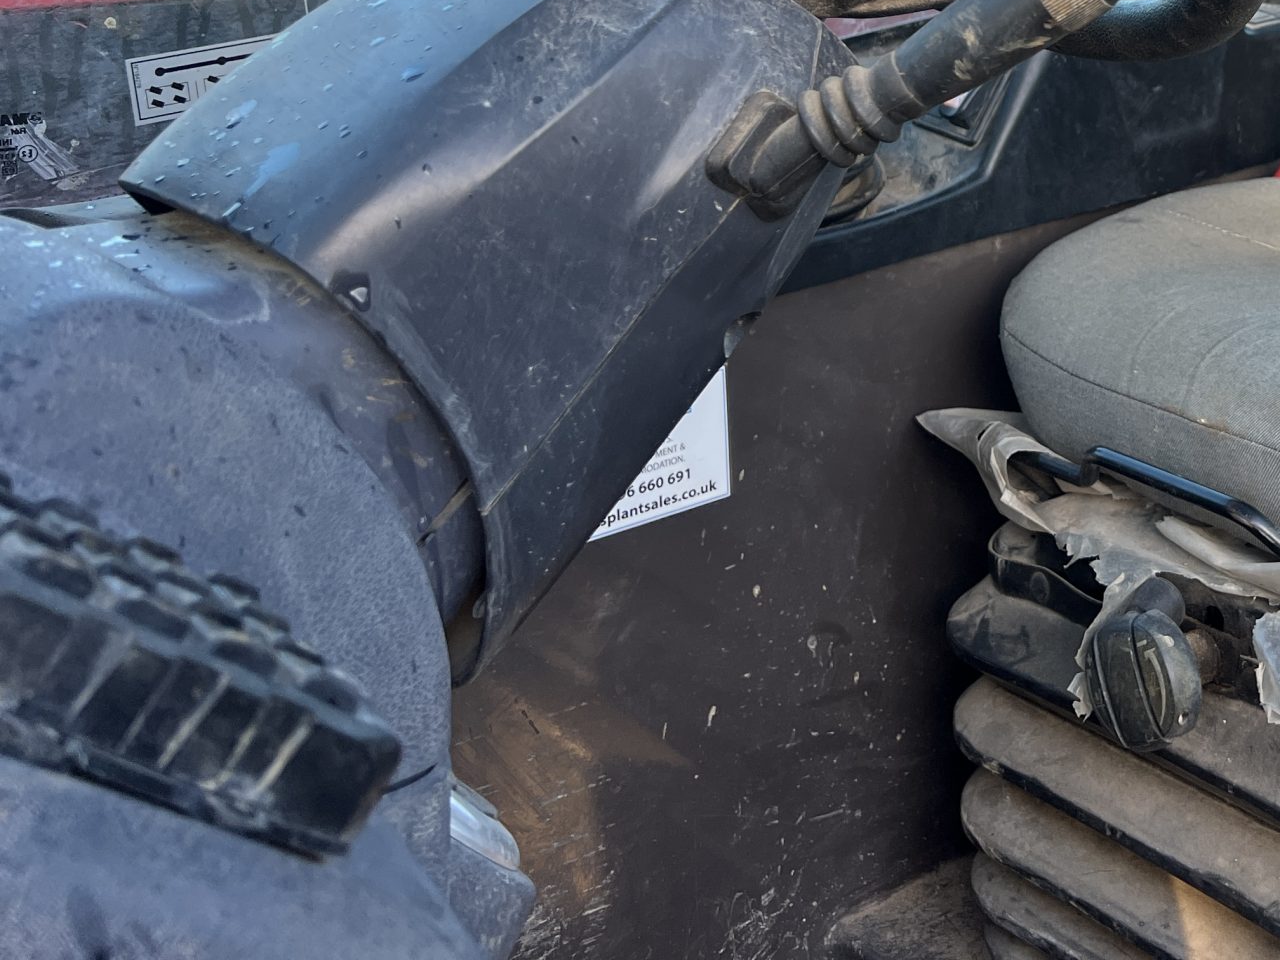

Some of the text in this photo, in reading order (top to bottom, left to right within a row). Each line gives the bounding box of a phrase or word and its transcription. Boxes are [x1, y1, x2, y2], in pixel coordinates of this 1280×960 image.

[680, 442, 686, 451] &
[638, 477, 664, 494] 660
[667, 468, 691, 485] 691
